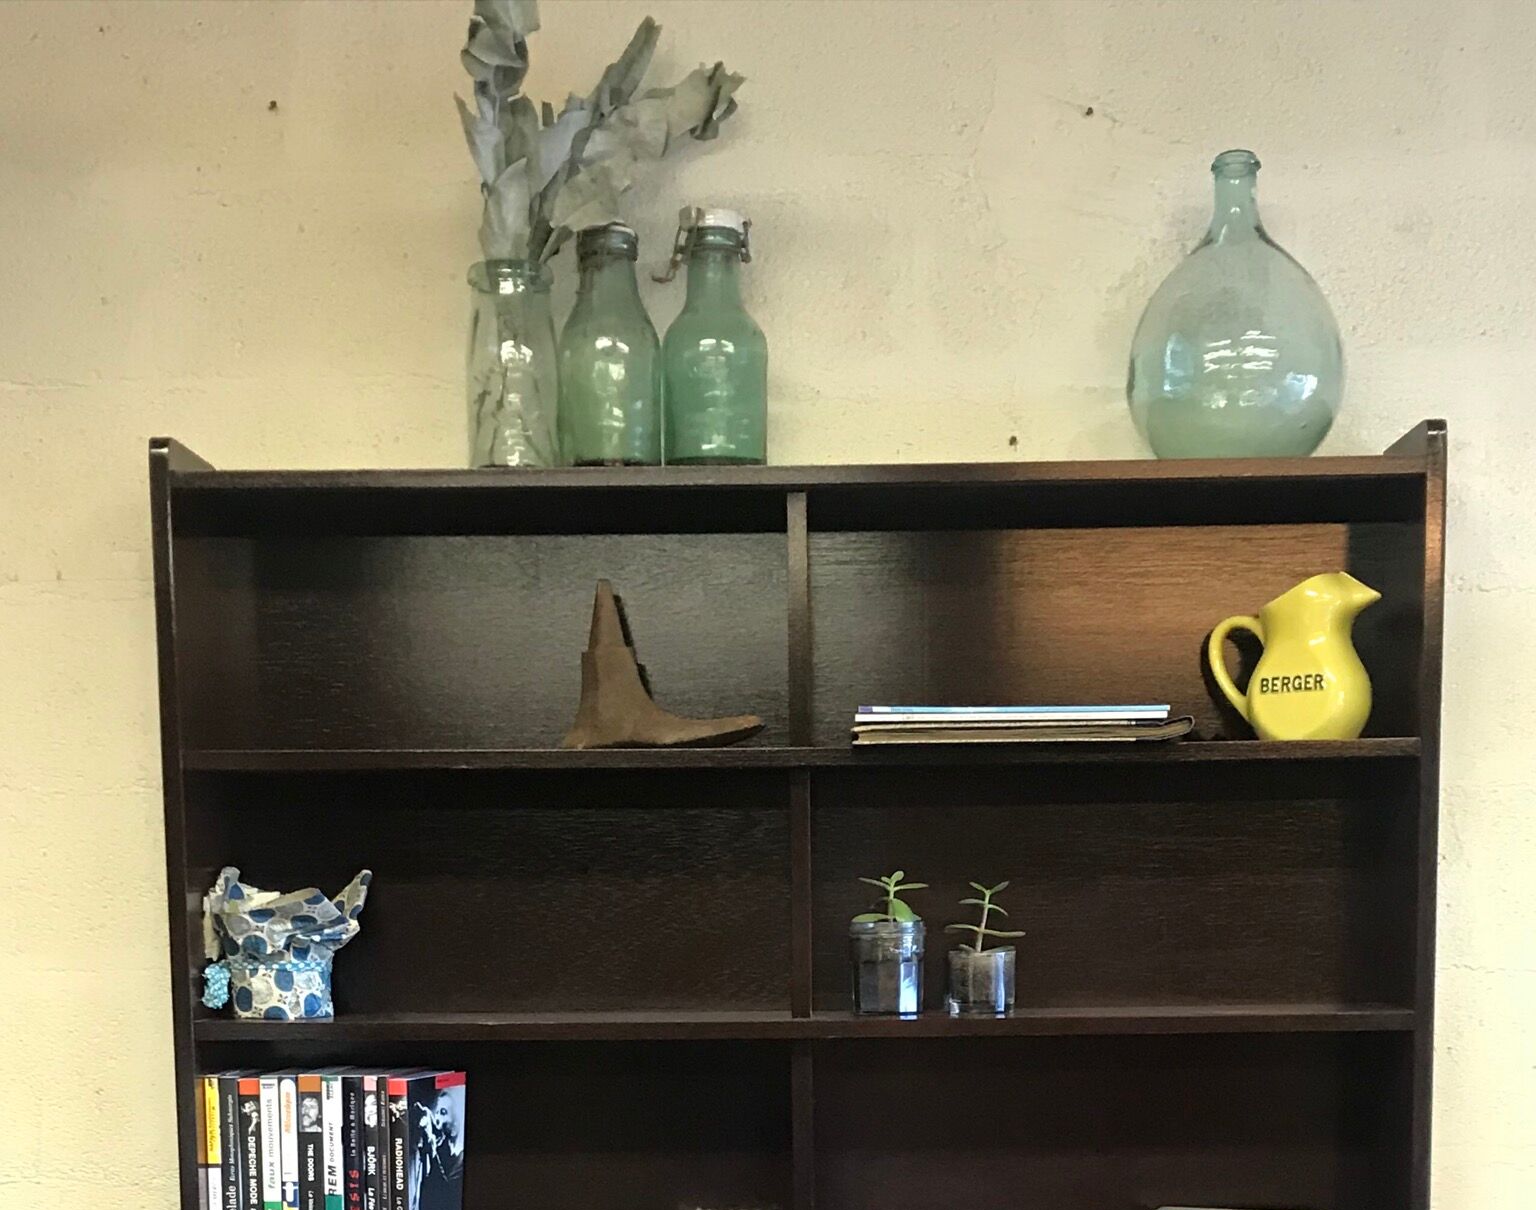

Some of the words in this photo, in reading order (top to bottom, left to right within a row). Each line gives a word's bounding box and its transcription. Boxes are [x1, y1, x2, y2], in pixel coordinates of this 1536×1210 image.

[1260, 674, 1324, 693] BERGER
[265, 1099, 274, 1158] mouvements
[328, 1122, 336, 1163] DOCUMENT
[247, 1136, 257, 1177] DEPECHE
[307, 1143, 315, 1157] THE
[367, 1146, 377, 1176] BJÖRK
[394, 1137, 404, 1191] RADIOHEAD
[307, 1157, 315, 1182] DOORS
[328, 1165, 337, 1195] REM
[249, 1179, 258, 1205] MODE
